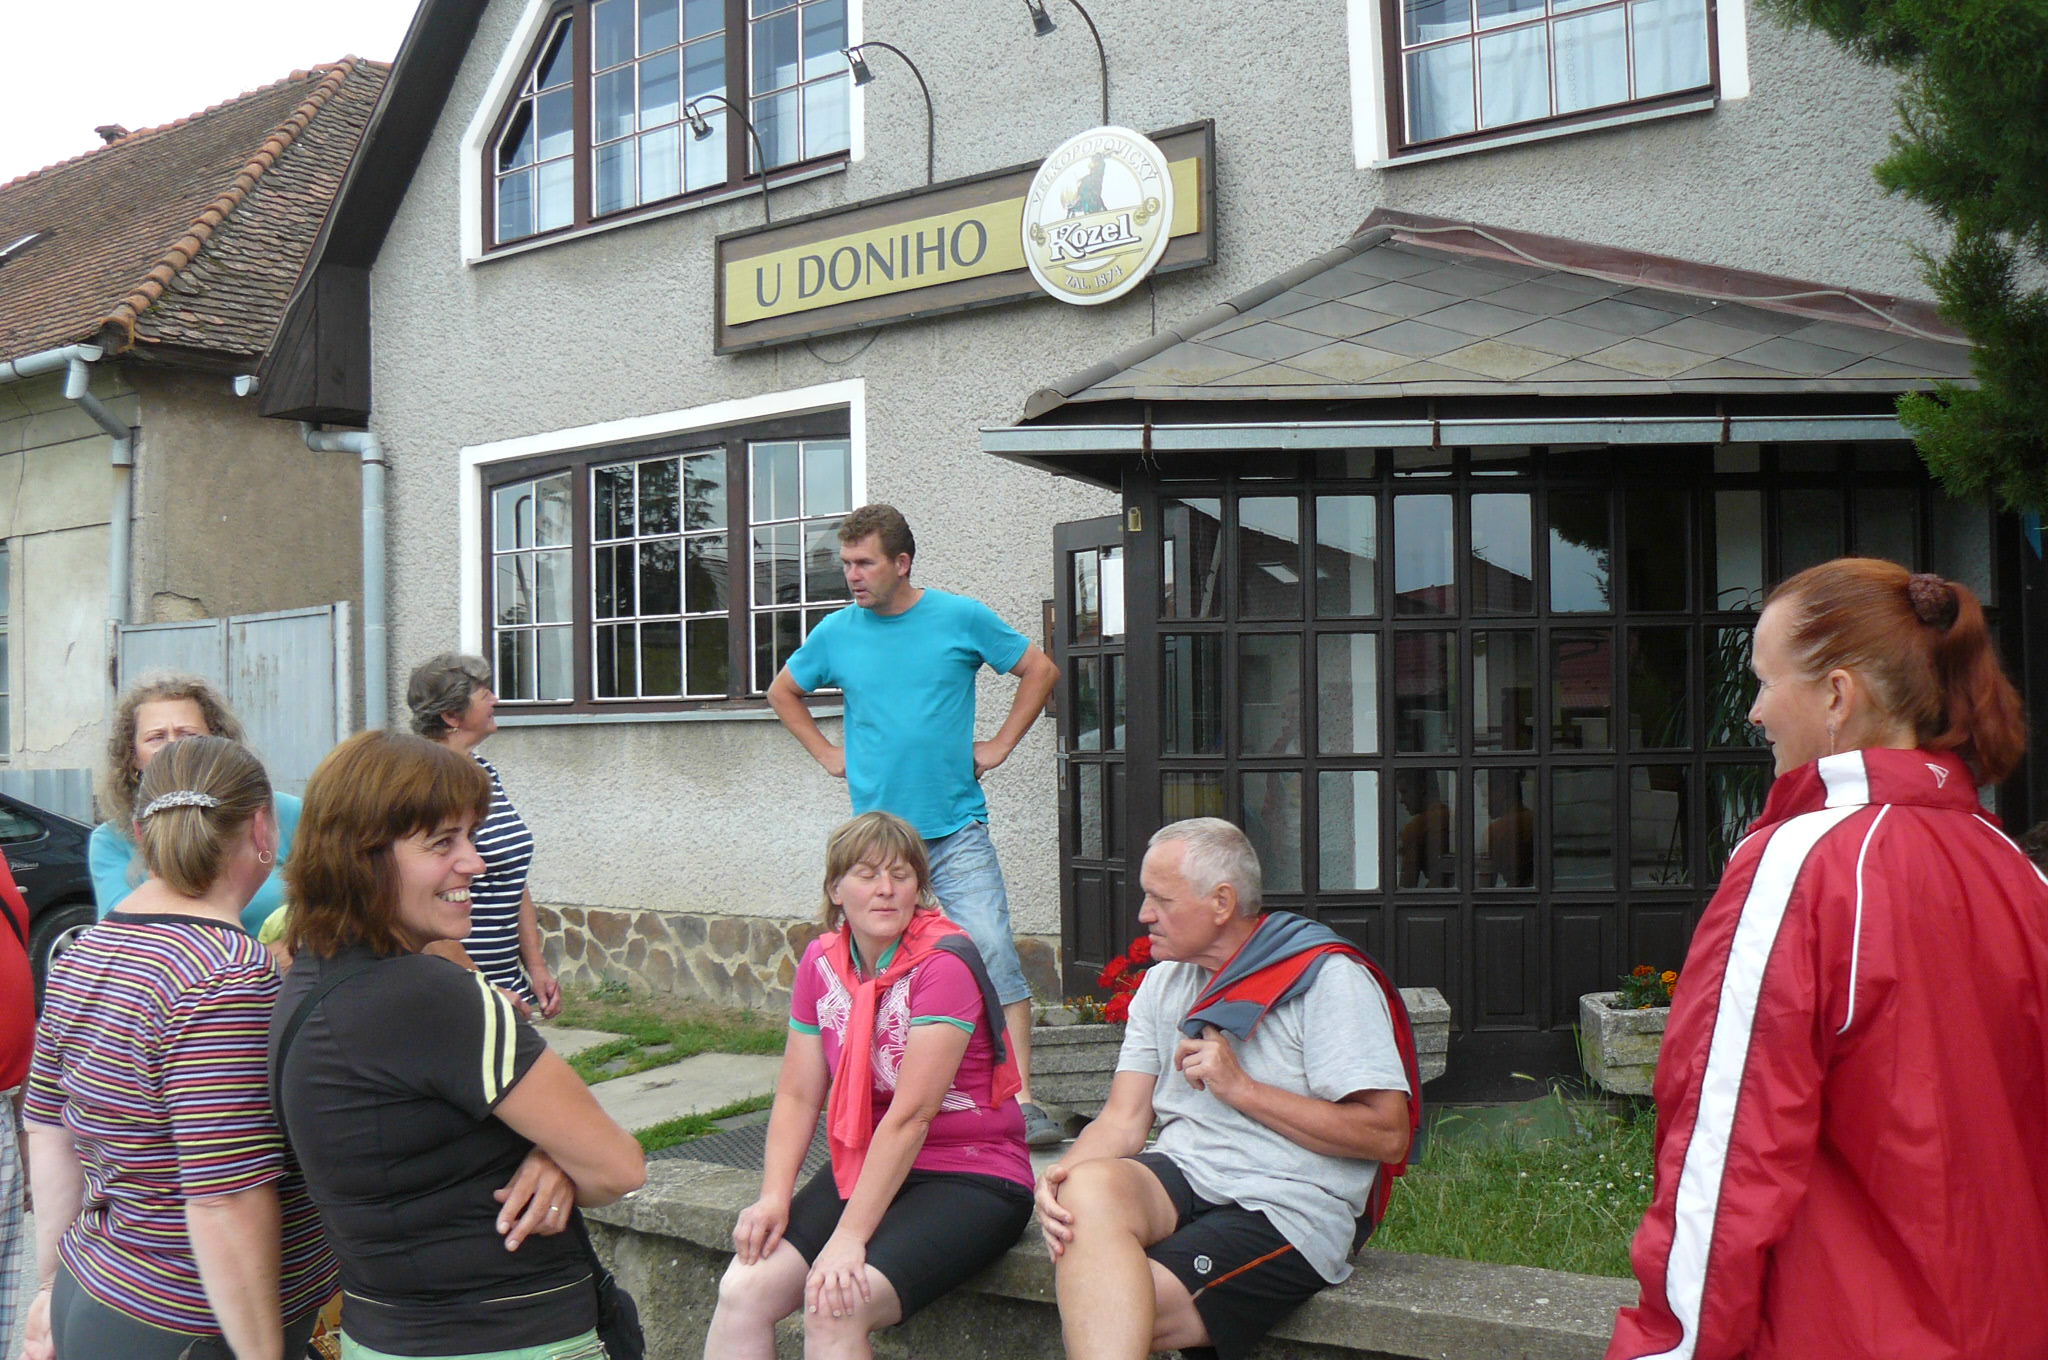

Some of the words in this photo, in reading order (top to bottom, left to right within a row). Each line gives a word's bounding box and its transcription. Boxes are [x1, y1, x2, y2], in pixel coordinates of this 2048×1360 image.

[1048, 214, 1142, 262] Kozel
[756, 263, 780, 307] U
[799, 220, 987, 298] DONIHO
[1094, 264, 1124, 289] 1874
